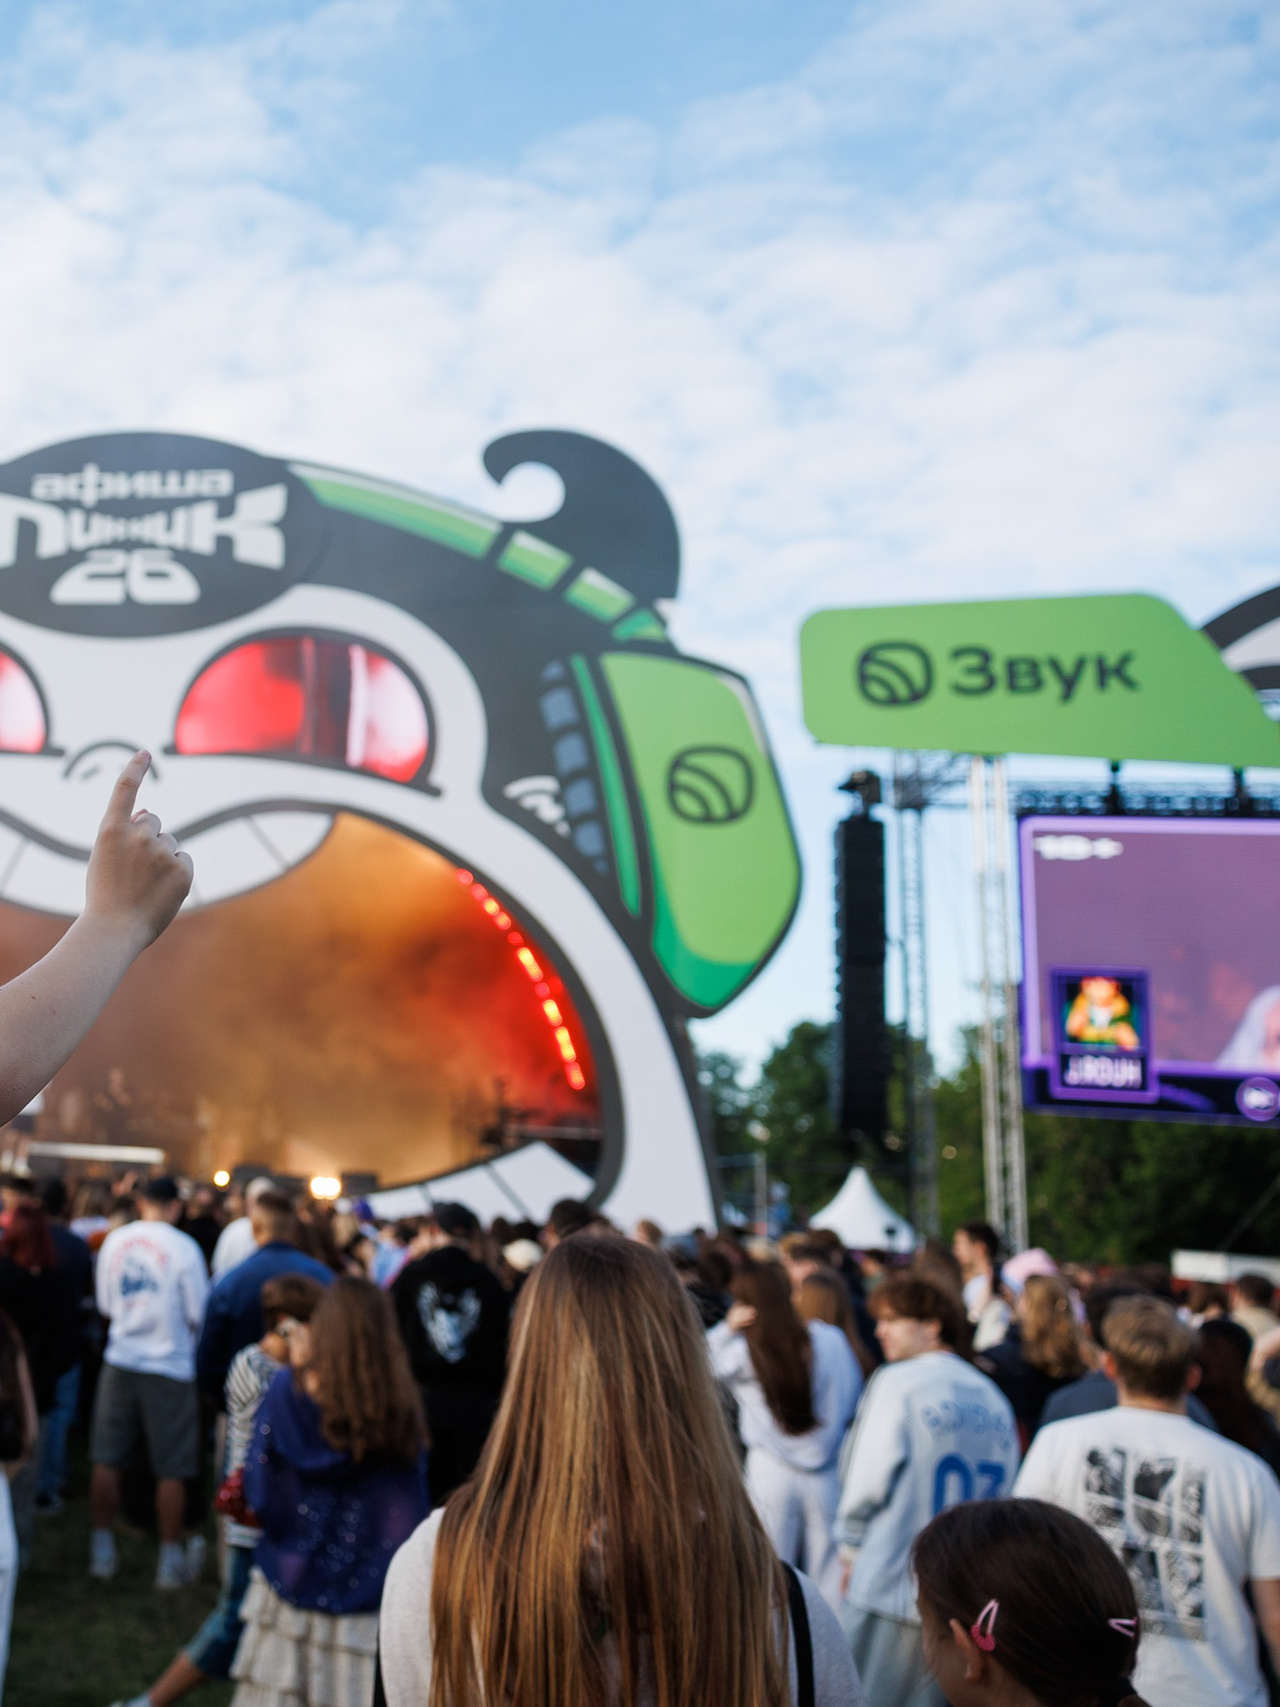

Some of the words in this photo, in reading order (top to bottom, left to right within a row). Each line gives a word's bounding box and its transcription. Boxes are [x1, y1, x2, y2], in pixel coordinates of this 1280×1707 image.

[31, 463, 234, 508] афиша
[50, 548, 200, 605] 26
[950, 643, 1138, 704] Звук
